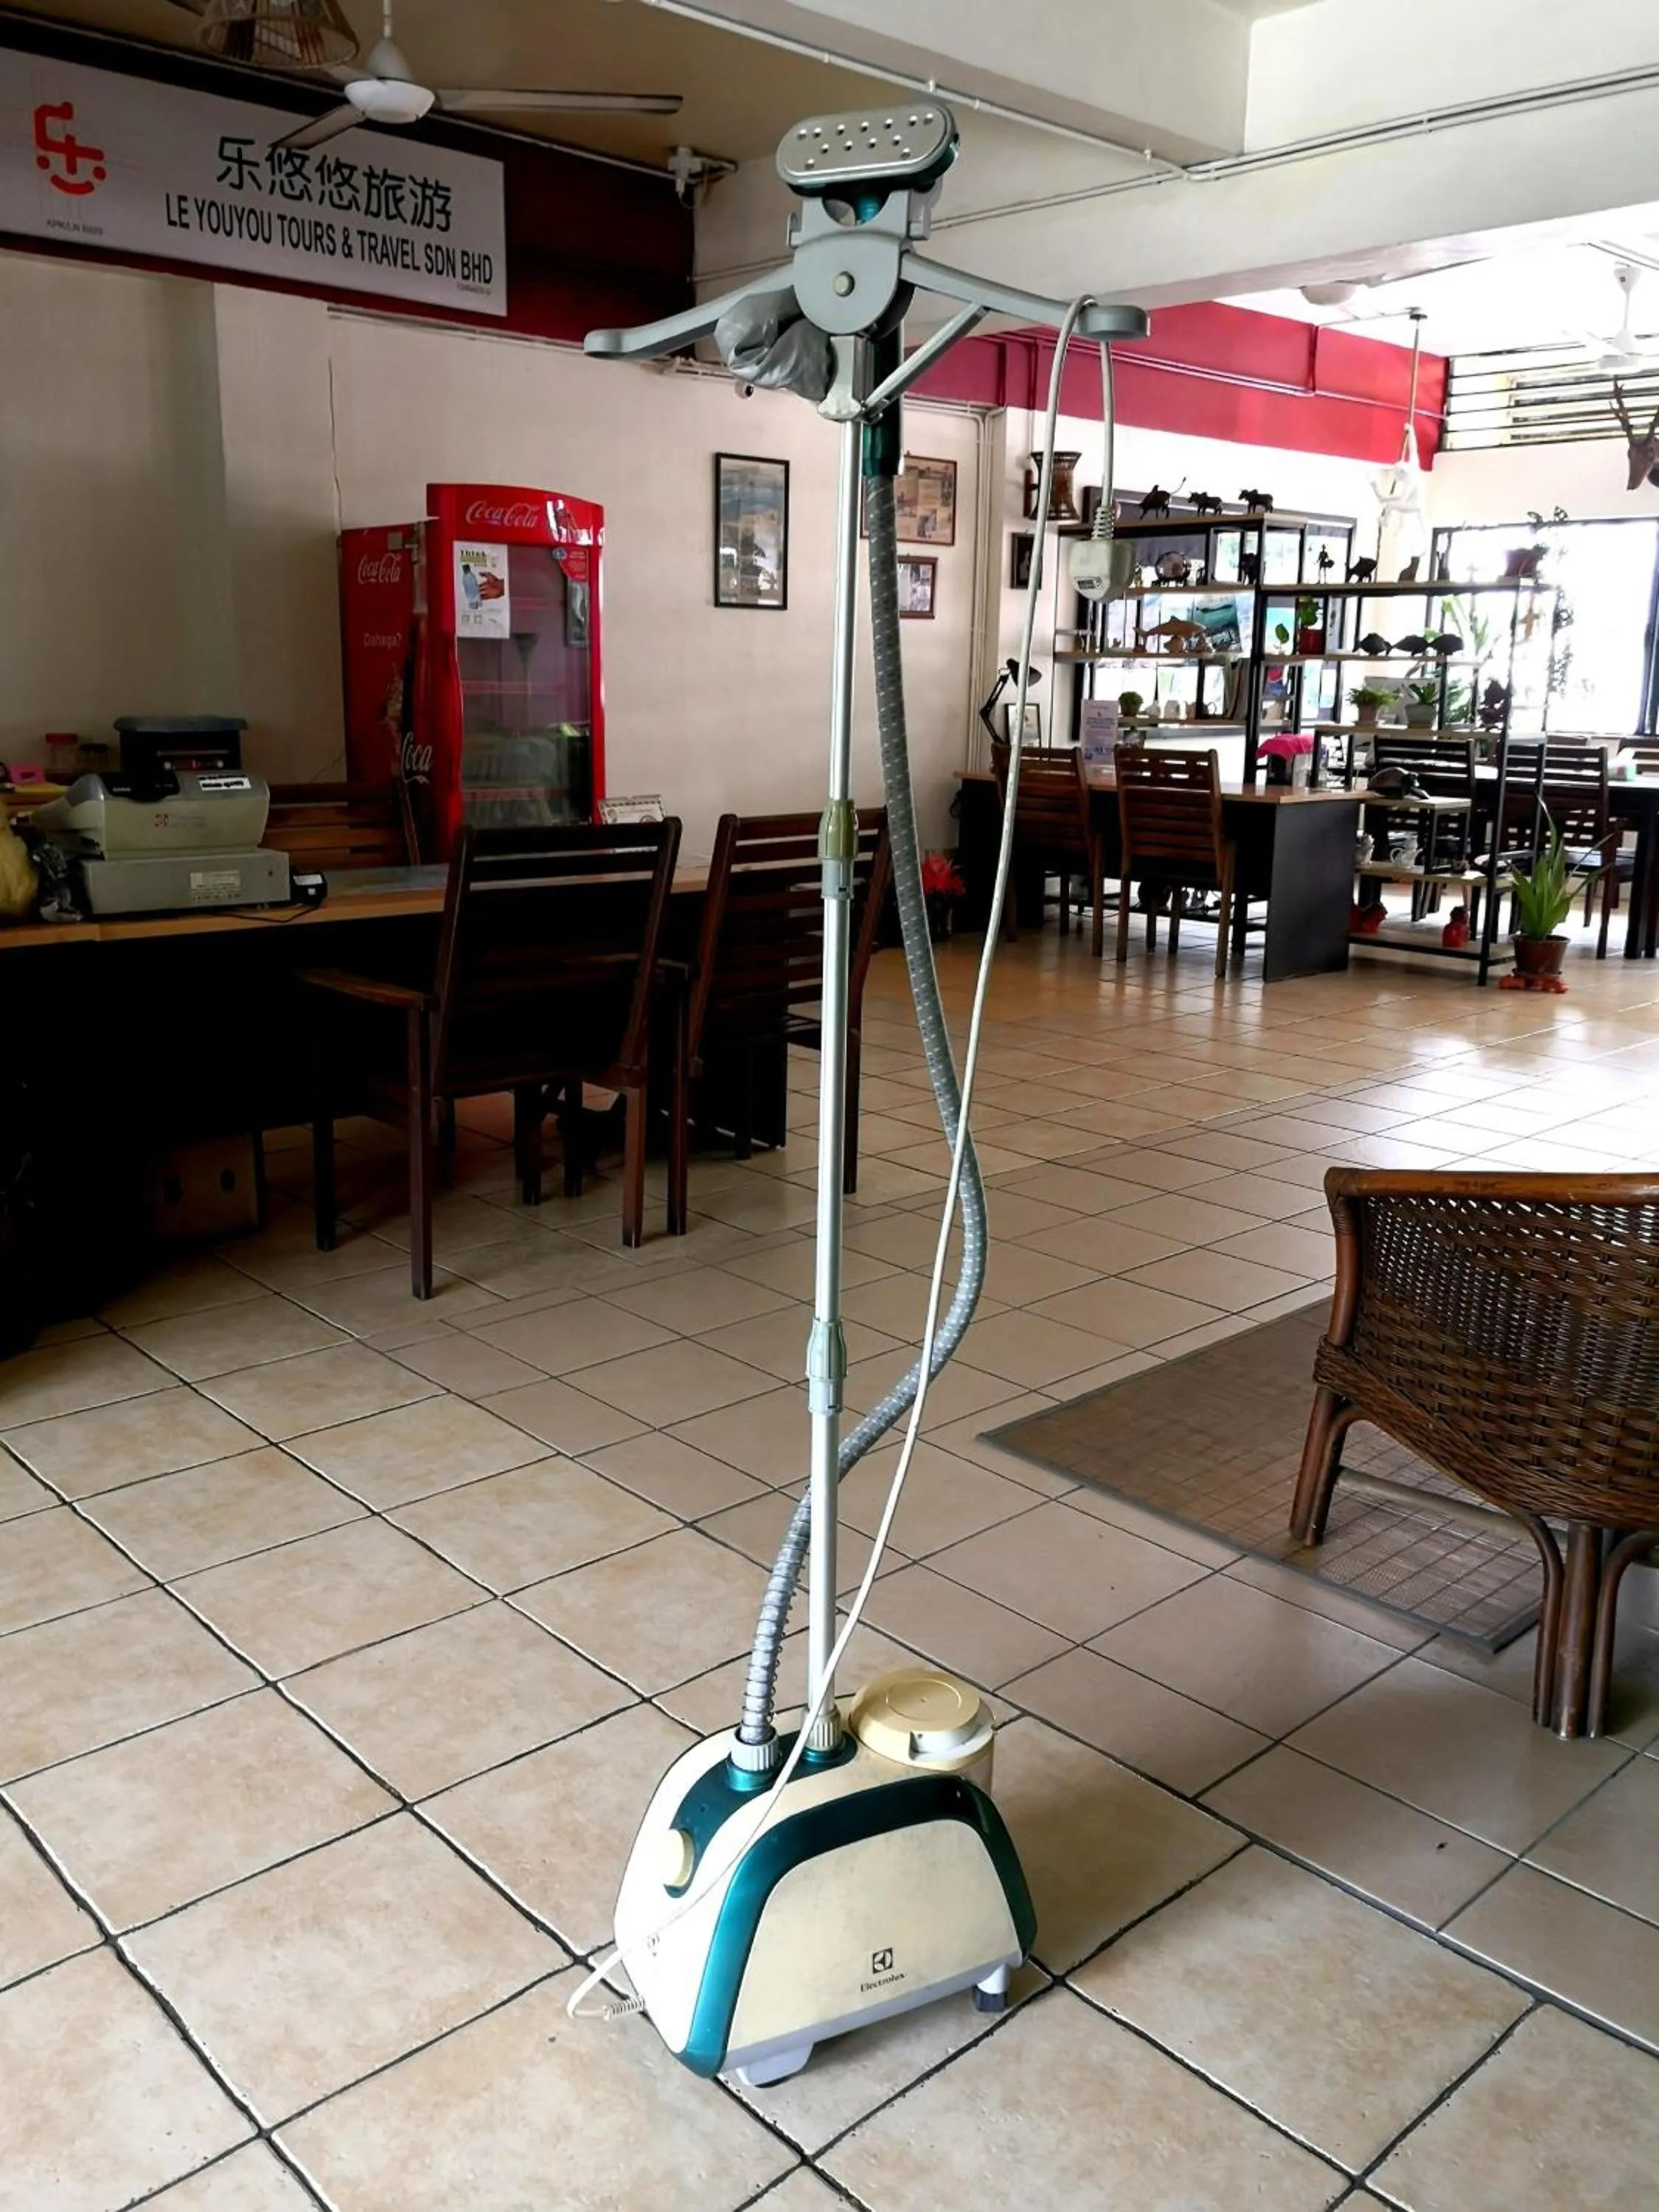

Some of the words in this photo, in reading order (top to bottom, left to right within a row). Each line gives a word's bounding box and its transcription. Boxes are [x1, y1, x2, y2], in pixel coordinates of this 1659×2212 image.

[217, 136, 452, 233] 乐悠悠旅游
[165, 192, 189, 230] LE
[193, 198, 273, 244] YOUYOU
[277, 214, 336, 257] TOURS
[341, 226, 353, 259] &
[357, 229, 420, 271] TRAVEL
[424, 242, 456, 279] SDN
[461, 250, 493, 285] BHD
